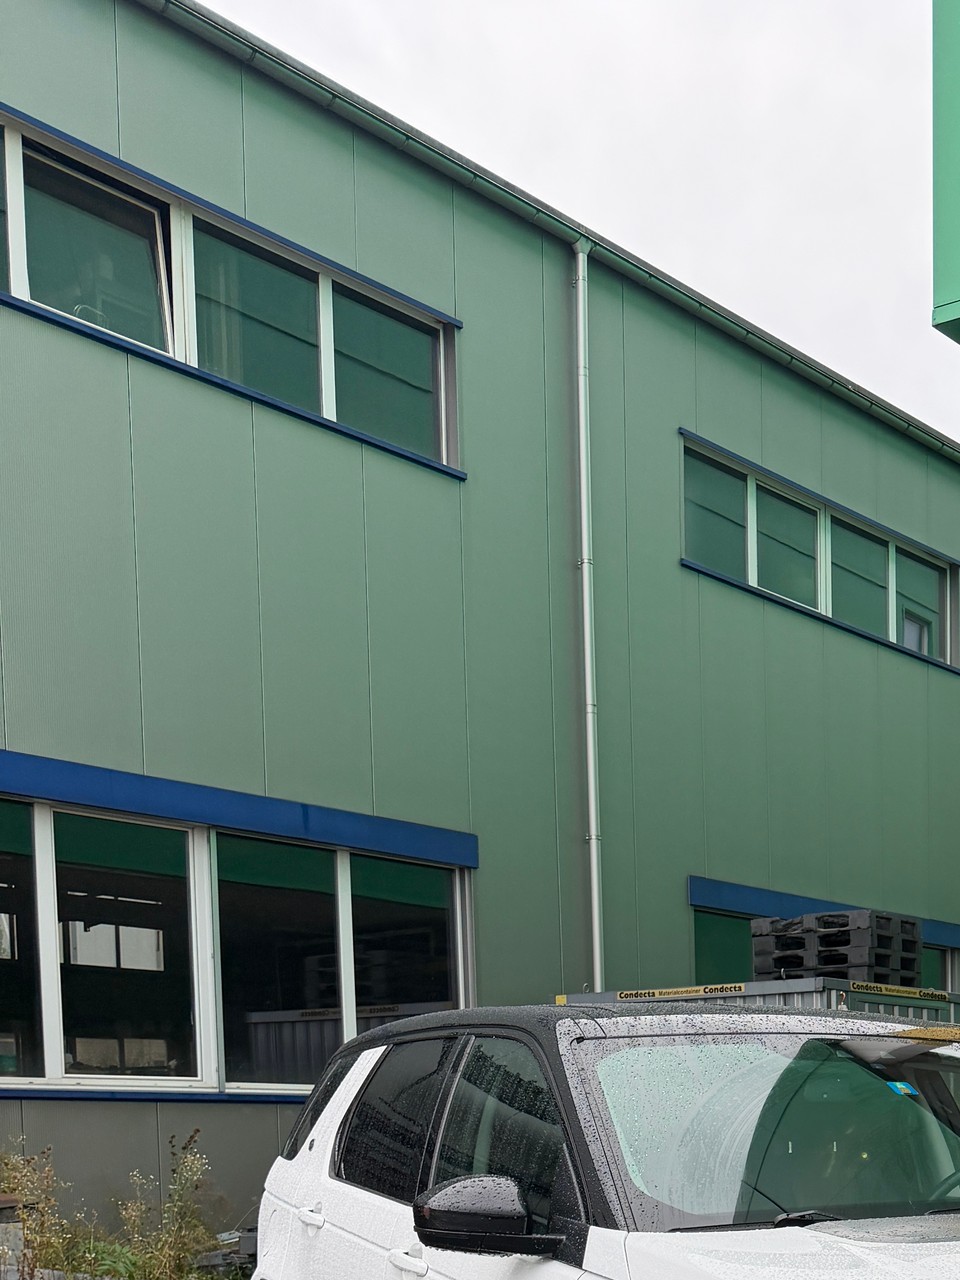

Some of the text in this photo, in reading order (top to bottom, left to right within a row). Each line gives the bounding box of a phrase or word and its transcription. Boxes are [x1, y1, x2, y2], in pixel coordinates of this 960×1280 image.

[619, 991, 656, 999] Condecta
[703, 985, 742, 994] Condecta
[852, 982, 883, 992] Condecta
[919, 990, 947, 1000] Condecta
